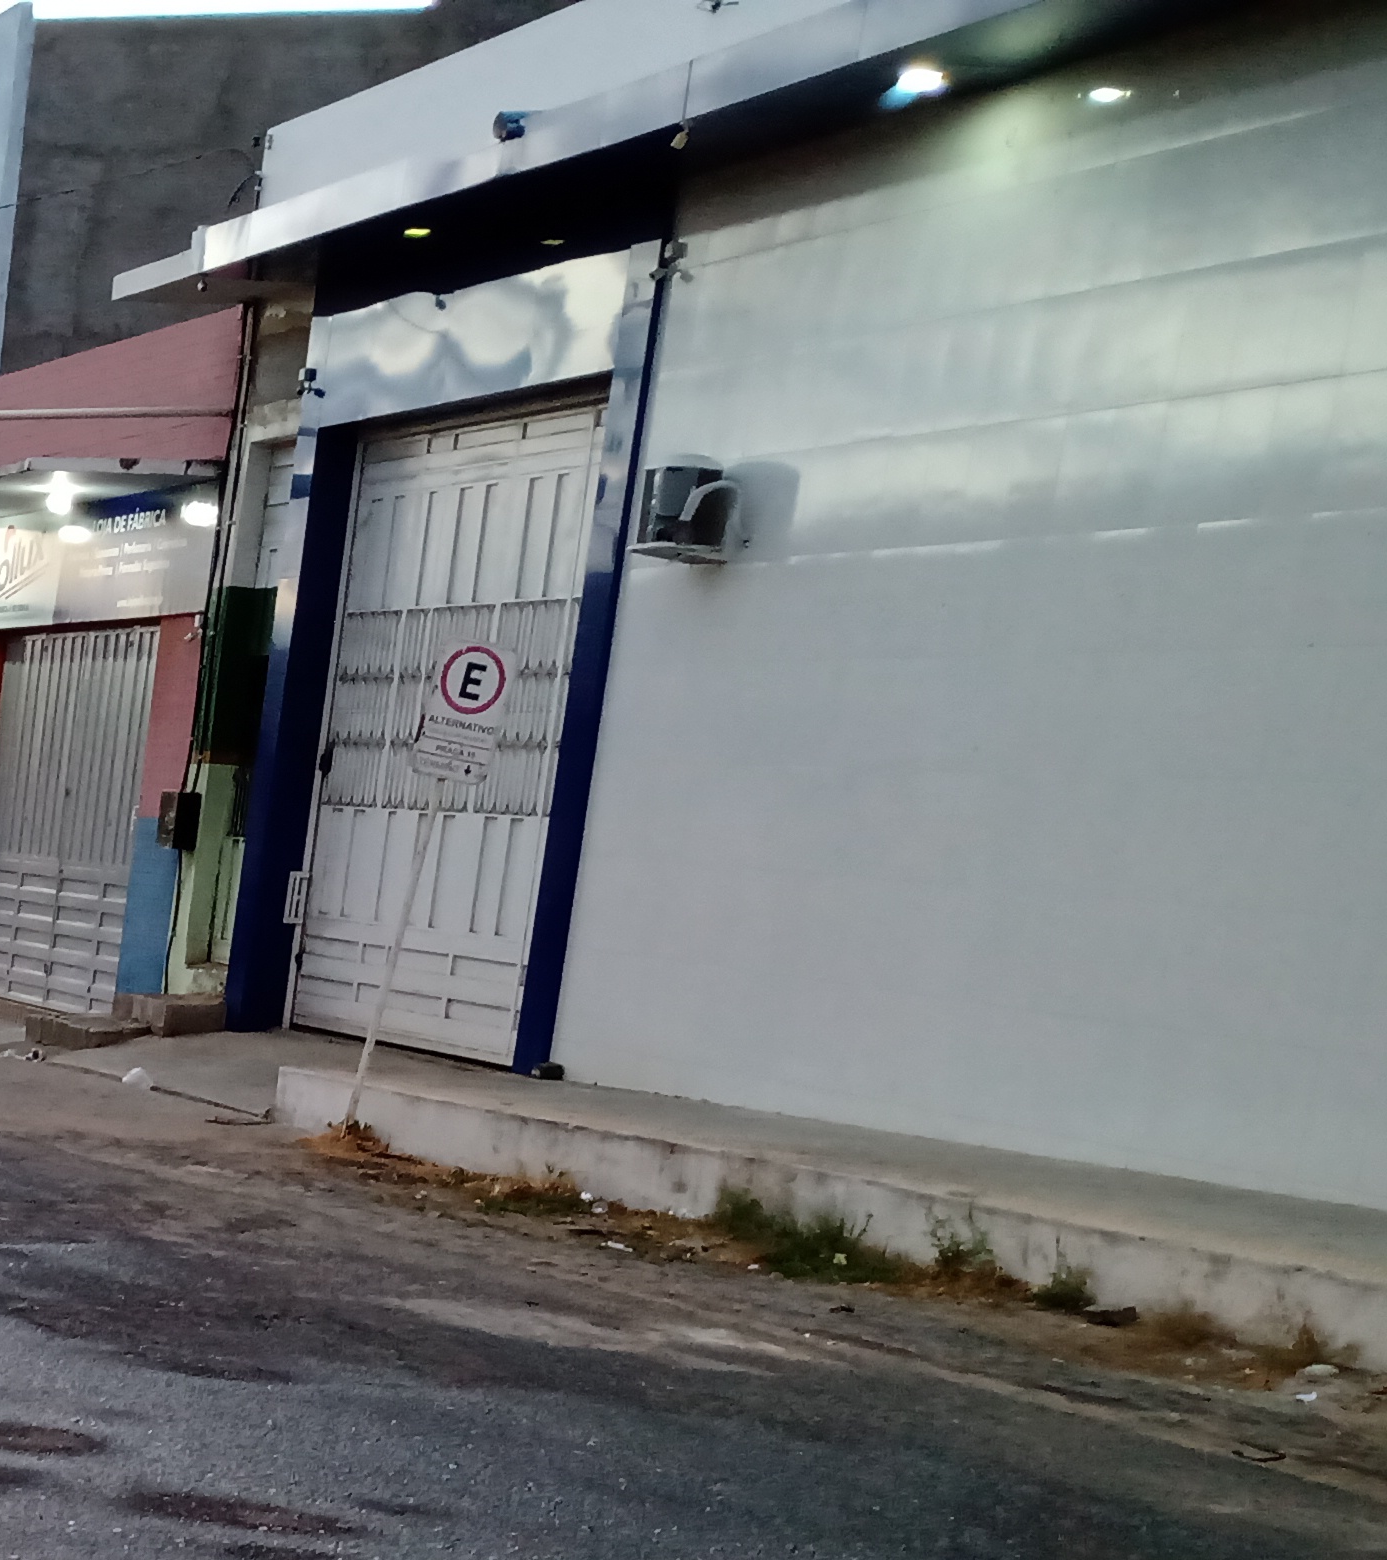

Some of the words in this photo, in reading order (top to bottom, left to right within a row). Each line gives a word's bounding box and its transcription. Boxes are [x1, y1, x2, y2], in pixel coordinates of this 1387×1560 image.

[113, 514, 127, 533] DE
[127, 507, 167, 531] FÁBRICA
[458, 661, 487, 701] E
[428, 714, 495, 736] ALTERNATIVO
